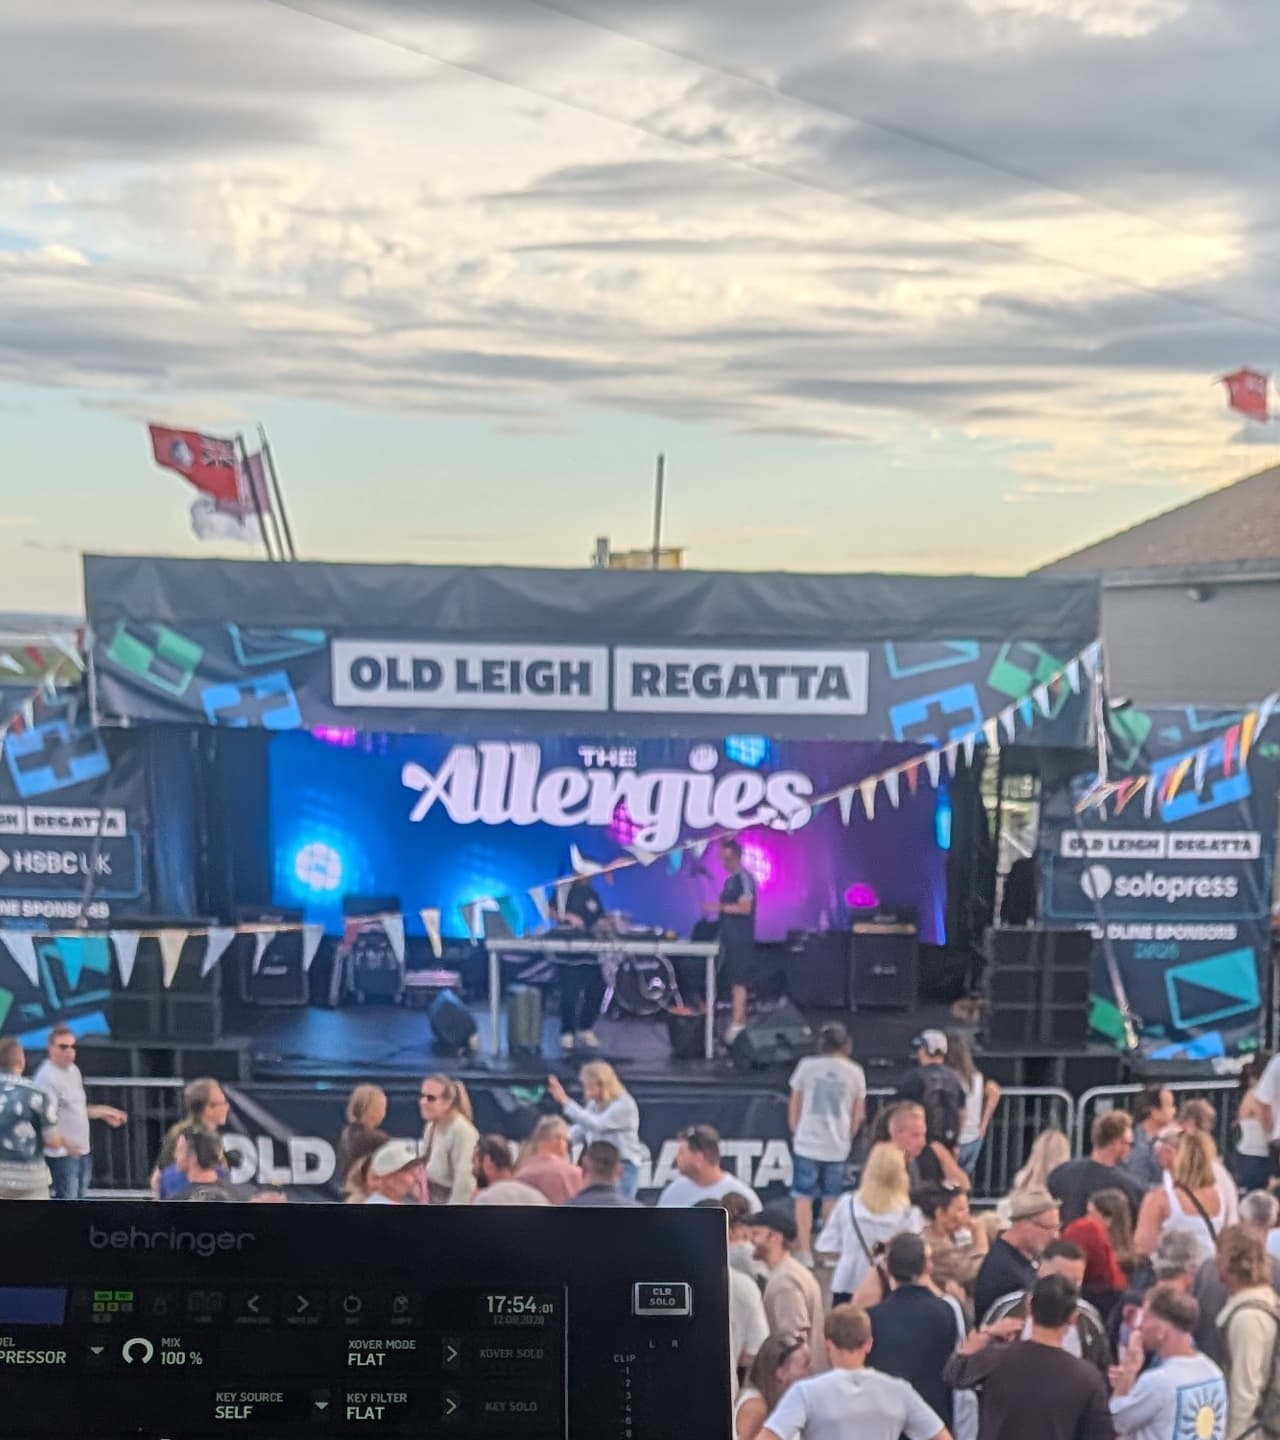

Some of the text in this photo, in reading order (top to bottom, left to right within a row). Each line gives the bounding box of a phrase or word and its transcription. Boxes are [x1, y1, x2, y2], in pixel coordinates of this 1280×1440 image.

[349, 655, 594, 697] OLD LEIGH
[631, 662, 850, 701] REGATTA
[579, 746, 636, 767] THE
[402, 740, 813, 852] Allergies
[34, 815, 118, 828] REGATTA
[1070, 839, 1159, 850] OLD LEIGH
[1175, 840, 1251, 850] REGATTA
[13, 851, 112, 875] HSBC UK
[1114, 871, 1238, 903] solopress
[1156, 924, 1237, 940] SPONSORS
[224, 1137, 334, 1185] OLD
[89, 1226, 256, 1256] behringer
[652, 1286, 672, 1297] CLR
[648, 1296, 676, 1306] SOLO
[161, 1338, 181, 1348] MIX
[348, 1339, 416, 1350] XOVER MODE
[160, 1352, 203, 1366] 100 %
[348, 1352, 386, 1366] FLAT
[216, 1392, 284, 1403] KEY SOURCE
[346, 1392, 408, 1404] KEY FILTER
[215, 1406, 252, 1420] SELF
[346, 1406, 384, 1420] FLAT
[485, 1401, 538, 1412] KEY SOLO
